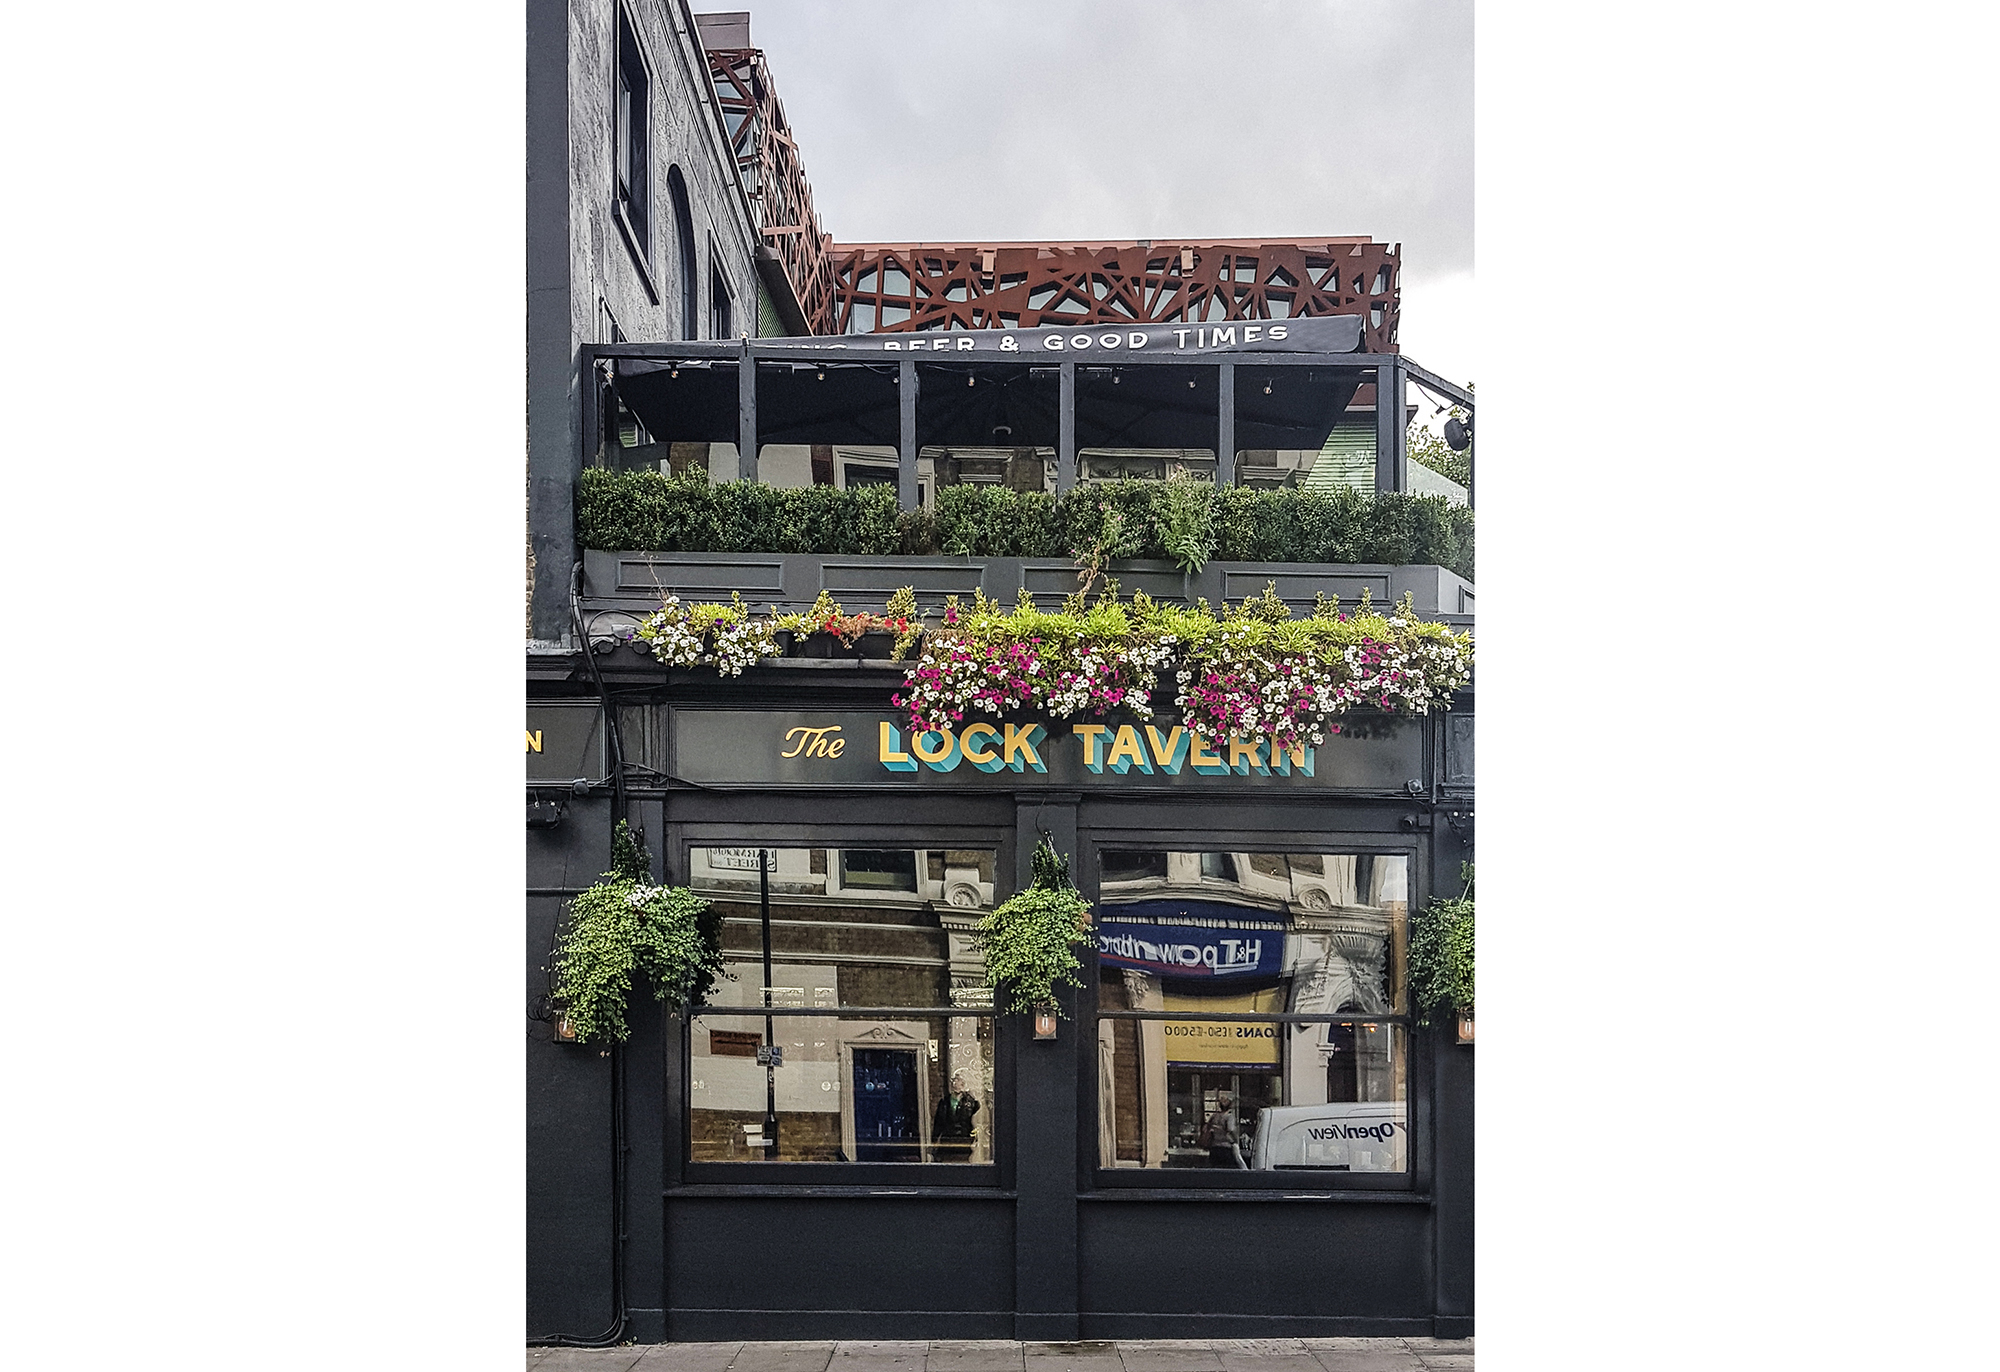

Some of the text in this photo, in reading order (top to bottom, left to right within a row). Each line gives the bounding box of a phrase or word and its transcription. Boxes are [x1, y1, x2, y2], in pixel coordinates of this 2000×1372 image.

[884, 326, 1288, 352] BEER & GOOD TIMES
[781, 722, 1314, 777] The LOCK TAVERN
